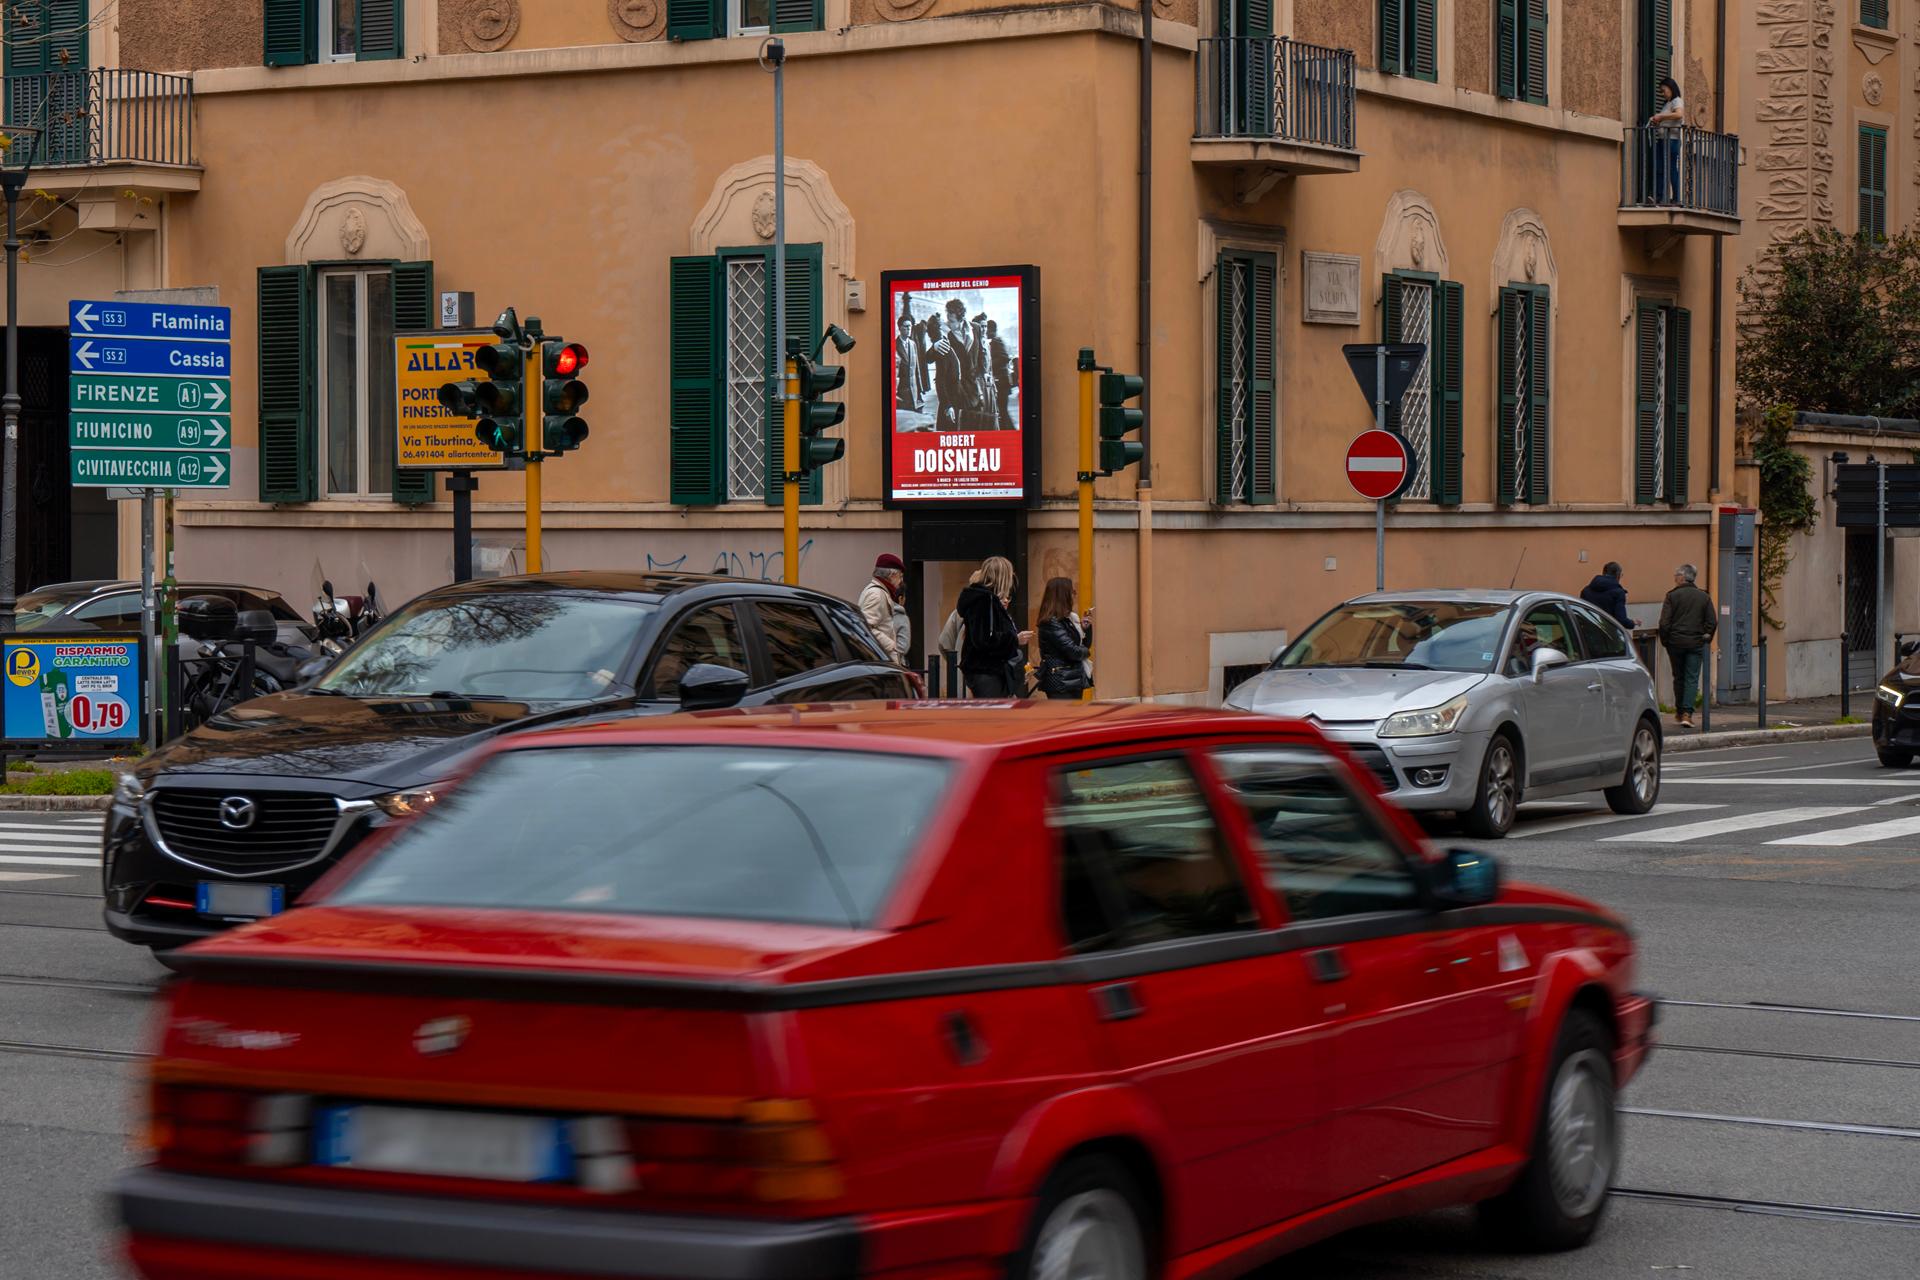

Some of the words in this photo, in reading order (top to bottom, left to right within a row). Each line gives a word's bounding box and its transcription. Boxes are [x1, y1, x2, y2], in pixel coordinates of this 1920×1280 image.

[1327, 272, 1340, 285] VIA
[105, 313, 116, 323] SS
[117, 314, 122, 324] 3
[151, 312, 225, 331] Flaminia
[106, 351, 116, 361] SS
[118, 352, 123, 361] 2
[169, 350, 225, 367] Cassia
[407, 351, 476, 371] ALLAR
[77, 384, 159, 403] FIRENZE
[402, 406, 454, 418] FINESTR
[76, 421, 152, 439] FIUMICINO
[403, 436, 422, 446] Via
[425, 435, 476, 447] Tiburtina,
[940, 435, 976, 447] ROBERT
[77, 459, 172, 477] CIVITAVECCHIA
[914, 448, 1001, 473] DOISNEAU
[56, 646, 127, 656] RISPARMIO
[54, 657, 129, 667] GARANTITO
[72, 695, 123, 730] 0,79
